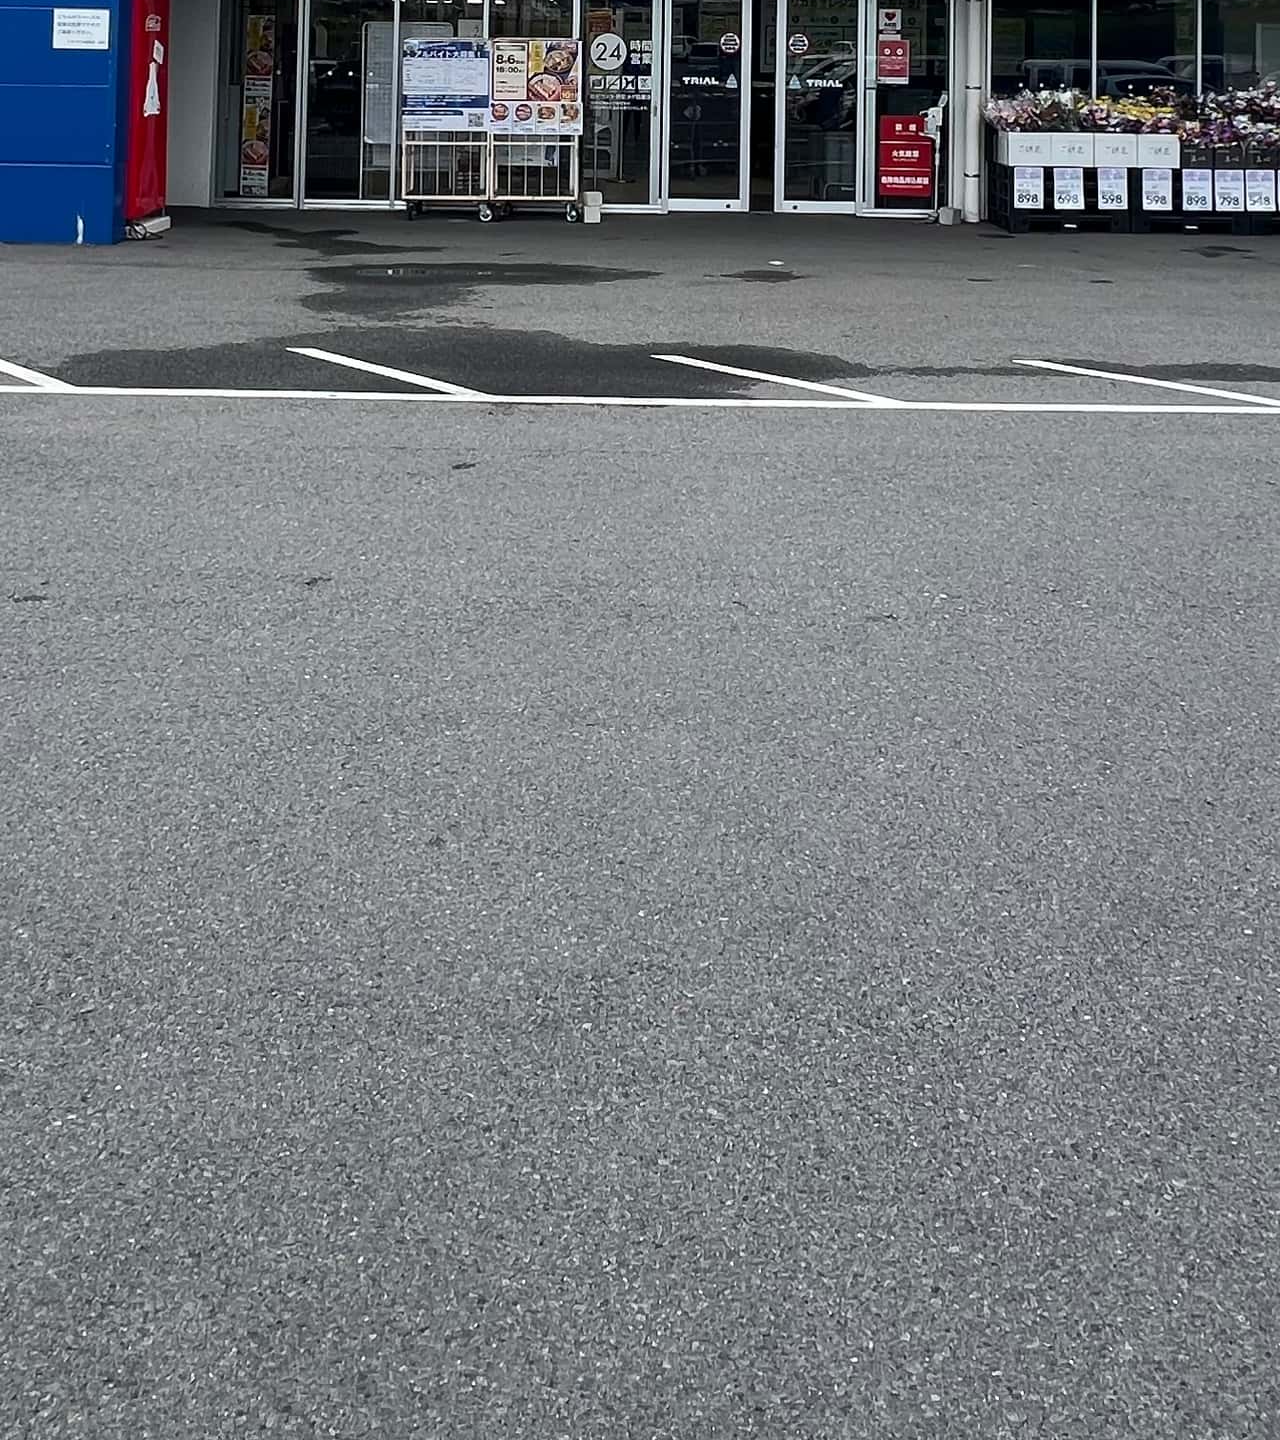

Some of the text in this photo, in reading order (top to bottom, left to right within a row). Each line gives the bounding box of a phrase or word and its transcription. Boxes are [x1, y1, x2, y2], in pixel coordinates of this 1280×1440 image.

[594, 42, 622, 61] 24
[682, 76, 719, 85] TRIAL
[806, 79, 843, 88] TRIAL
[1017, 193, 1039, 204] 898
[1057, 193, 1079, 204] 698
[1101, 194, 1123, 204] 598
[1146, 195, 1168, 205] 598
[1186, 195, 1208, 206] 898
[1220, 196, 1239, 206] 798
